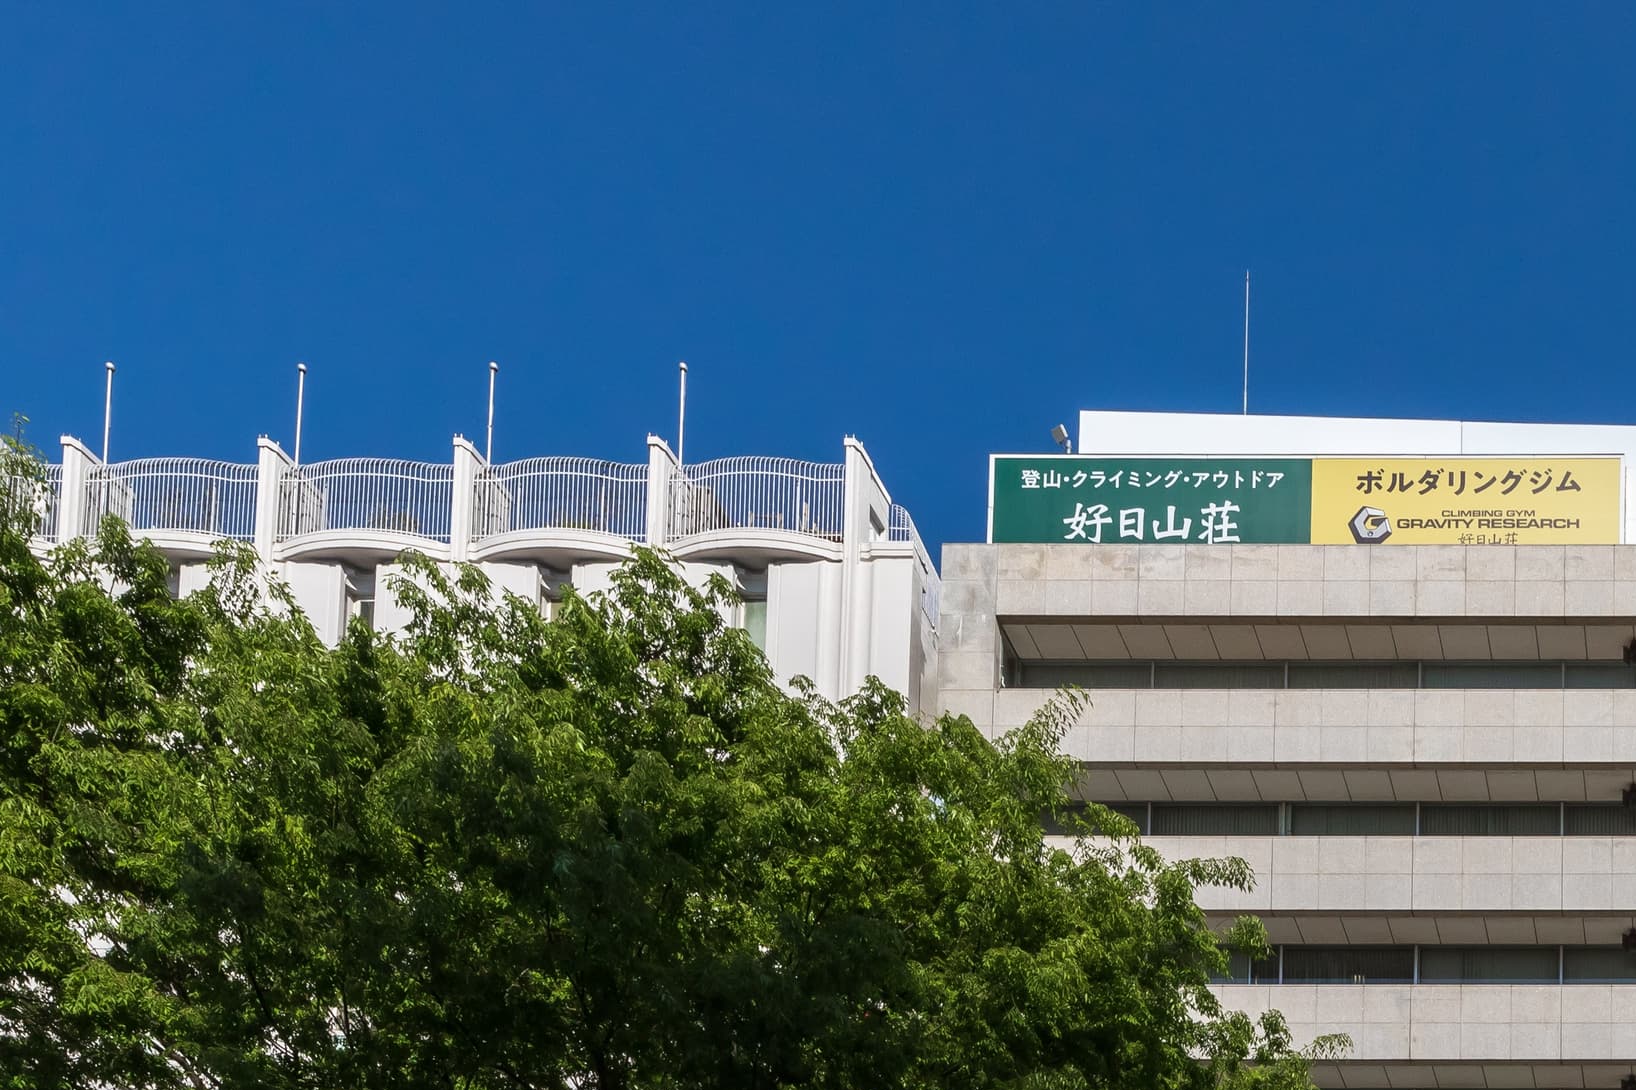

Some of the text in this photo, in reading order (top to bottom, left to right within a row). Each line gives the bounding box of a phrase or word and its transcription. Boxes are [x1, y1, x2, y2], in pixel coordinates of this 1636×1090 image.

[1020, 469, 1285, 490] 登山・クライミング・アウトドア
[1355, 468, 1582, 495] ボルダリングジム
[1062, 501, 1242, 544] 好日山荘
[1396, 518, 1581, 529] GRAVITY RESEARCH
[1441, 509, 1536, 518] CLIMBING GYM
